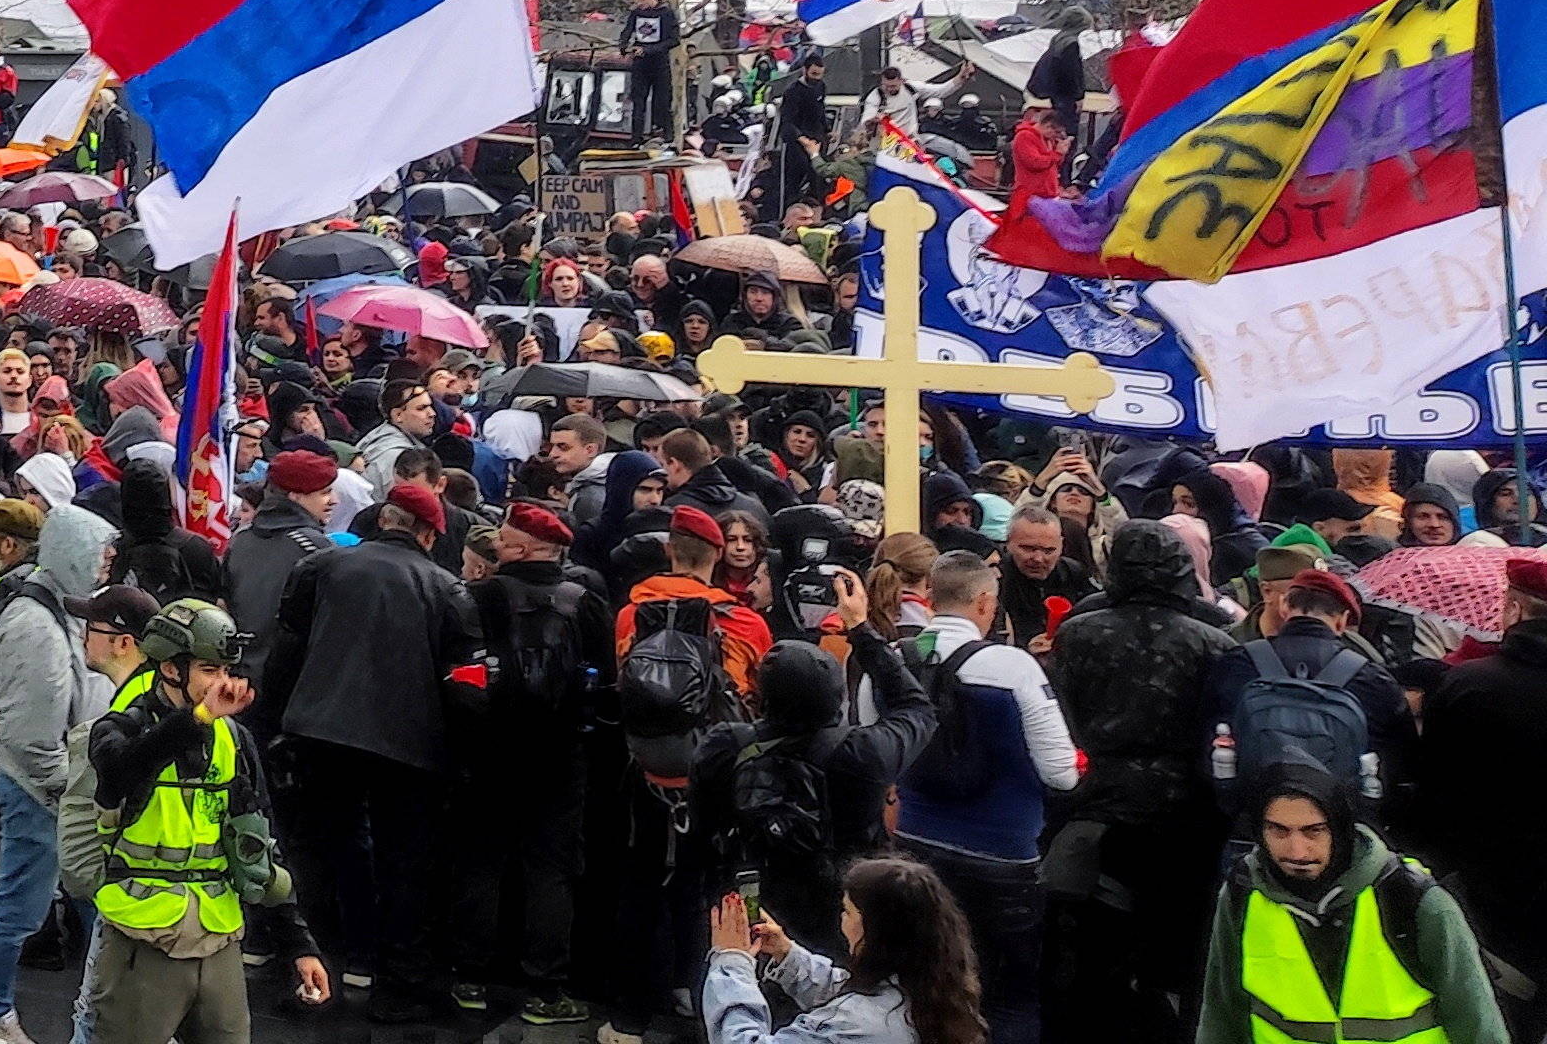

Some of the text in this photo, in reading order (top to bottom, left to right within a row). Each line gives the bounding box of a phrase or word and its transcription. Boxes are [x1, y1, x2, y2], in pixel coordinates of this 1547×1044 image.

[542, 177, 604, 193] EEP CALM
[552, 194, 581, 210] AND
